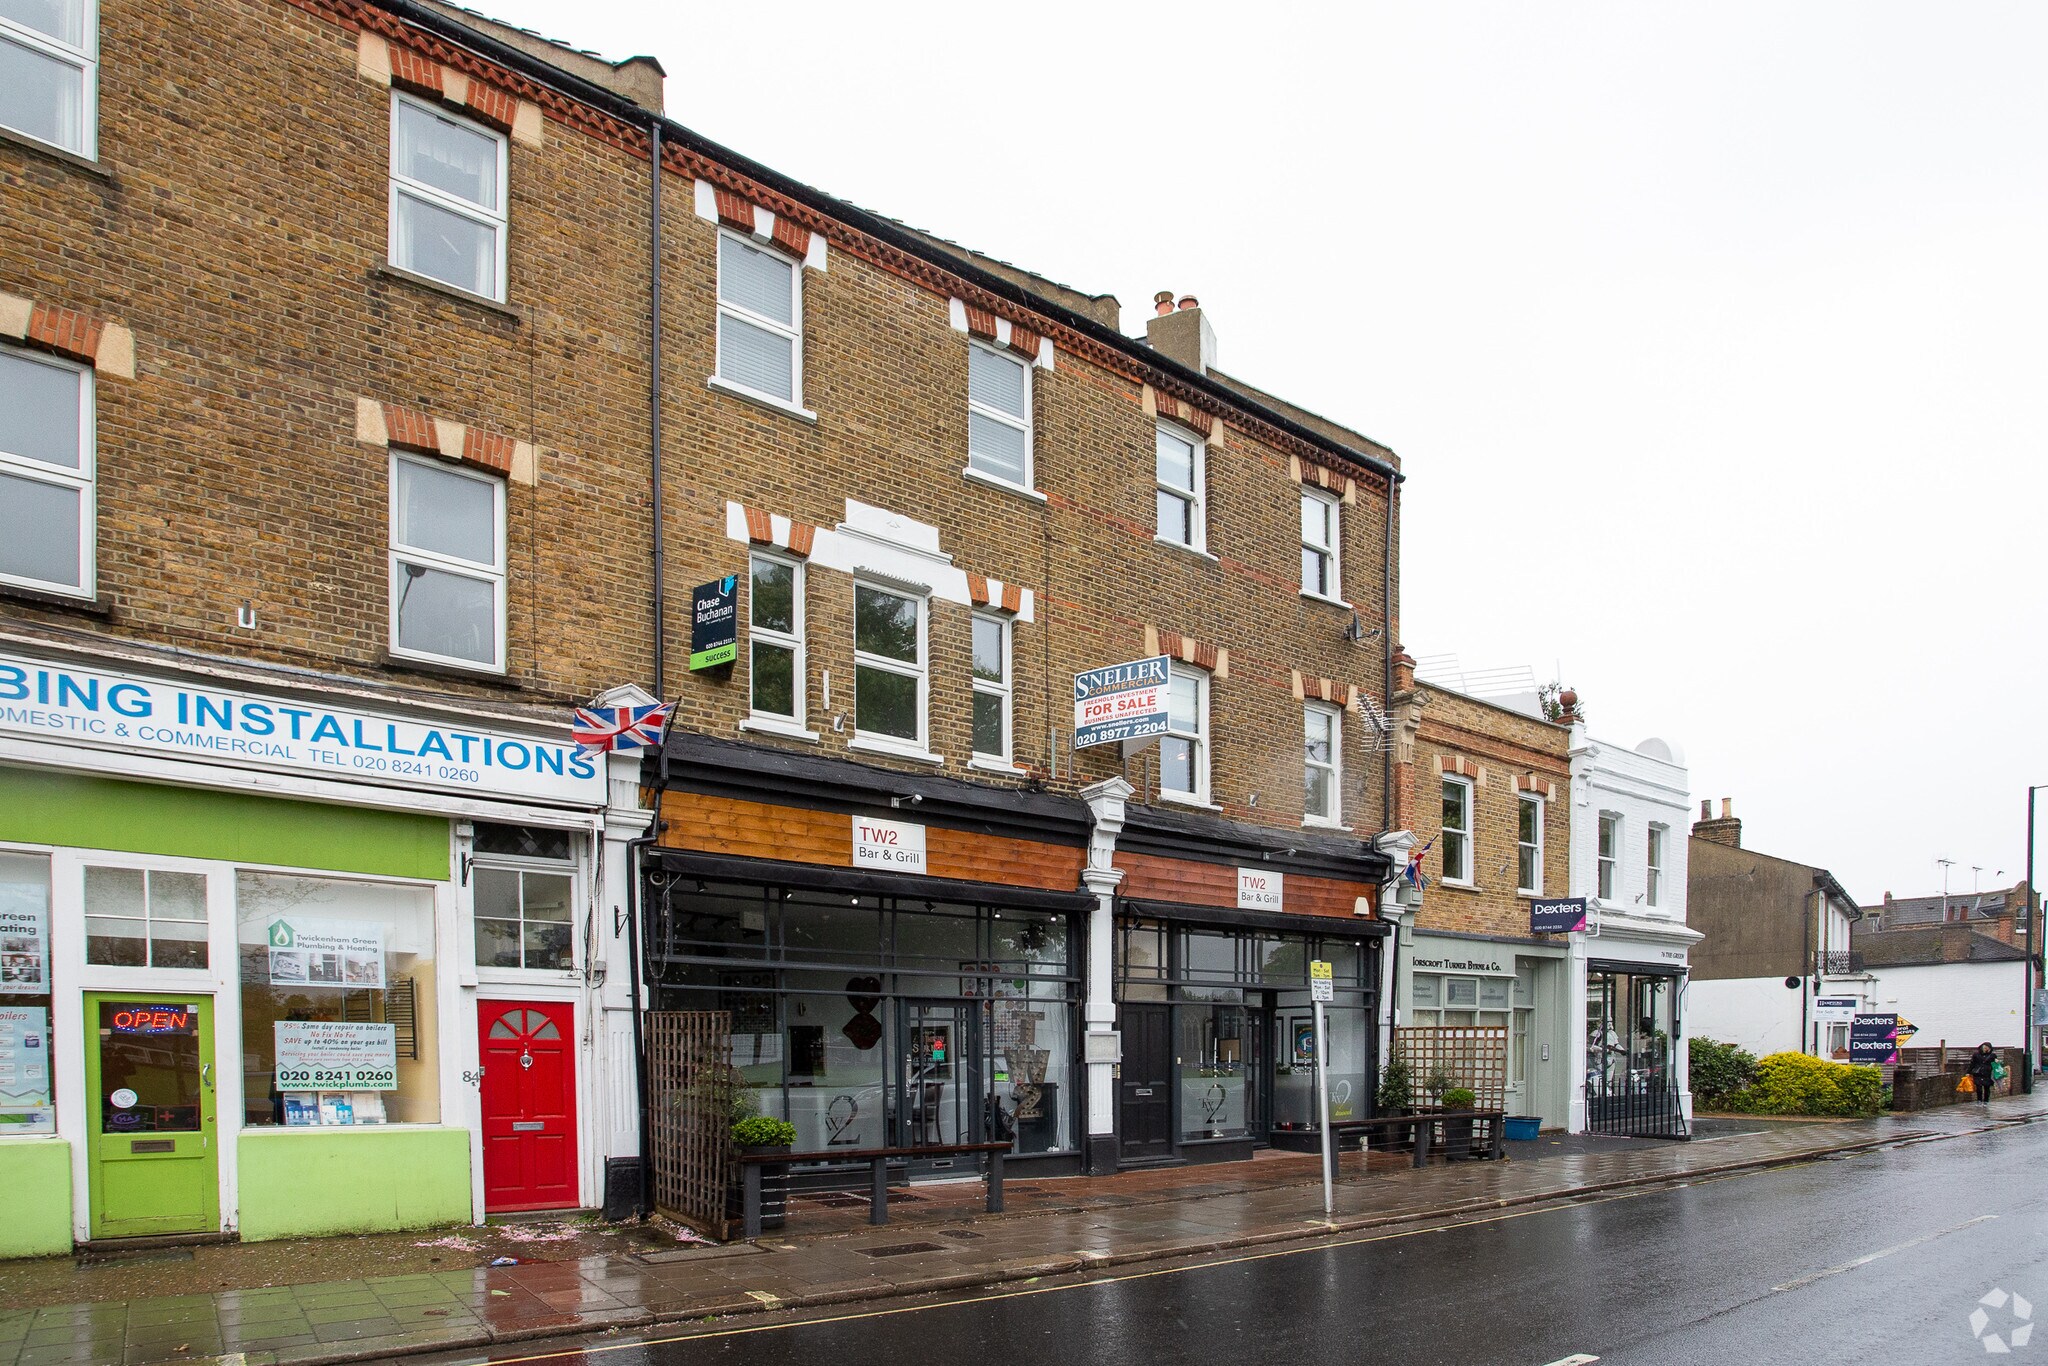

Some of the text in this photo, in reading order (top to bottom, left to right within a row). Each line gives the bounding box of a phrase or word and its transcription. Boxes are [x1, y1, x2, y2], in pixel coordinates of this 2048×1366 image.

[697, 597, 720, 612] Chase
[696, 605, 733, 624] Buchanan
[705, 649, 731, 663] success
[1076, 661, 1167, 699] SNELLER
[1088, 677, 1162, 697] COMMERCIAL
[1083, 687, 1158, 707] FREEHOLD INVESTMENT
[1085, 695, 1156, 718] FOR SALE
[0, 665, 596, 780] BING INSTALLATIONS
[1084, 707, 1157, 725] BUSINESS UNAFFECTED
[1077, 720, 1167, 746] 020 8977 2204
[114, 722, 130, 738] &
[138, 725, 297, 760] COMMERCIAL
[308, 748, 347, 766] TEL
[353, 755, 387, 772] 020
[391, 760, 432, 777] 8241
[438, 766, 479, 783] 0260
[859, 826, 898, 845] TW2
[859, 846, 920, 863] Bar & Grill
[1242, 875, 1266, 890] TW2
[1241, 891, 1279, 904] Bar & Grill
[1534, 903, 1582, 915] Dexters
[0, 913, 37, 921] reen
[297, 935, 378, 945] Twickenham Green
[297, 942, 336, 951] Plumbing
[347, 945, 378, 954] Heating
[113, 1011, 188, 1028] OPEN
[321, 1023, 333, 1031] day
[334, 1023, 355, 1031] repair
[365, 1023, 387, 1031] boilers
[1854, 1017, 1894, 1026] Dexters
[1852, 1041, 1893, 1050] Dexters
[280, 1071, 394, 1081] 020 8241 0260
[463, 1070, 480, 1082] 84
[281, 1080, 393, 1089] www.twickplumb.com
